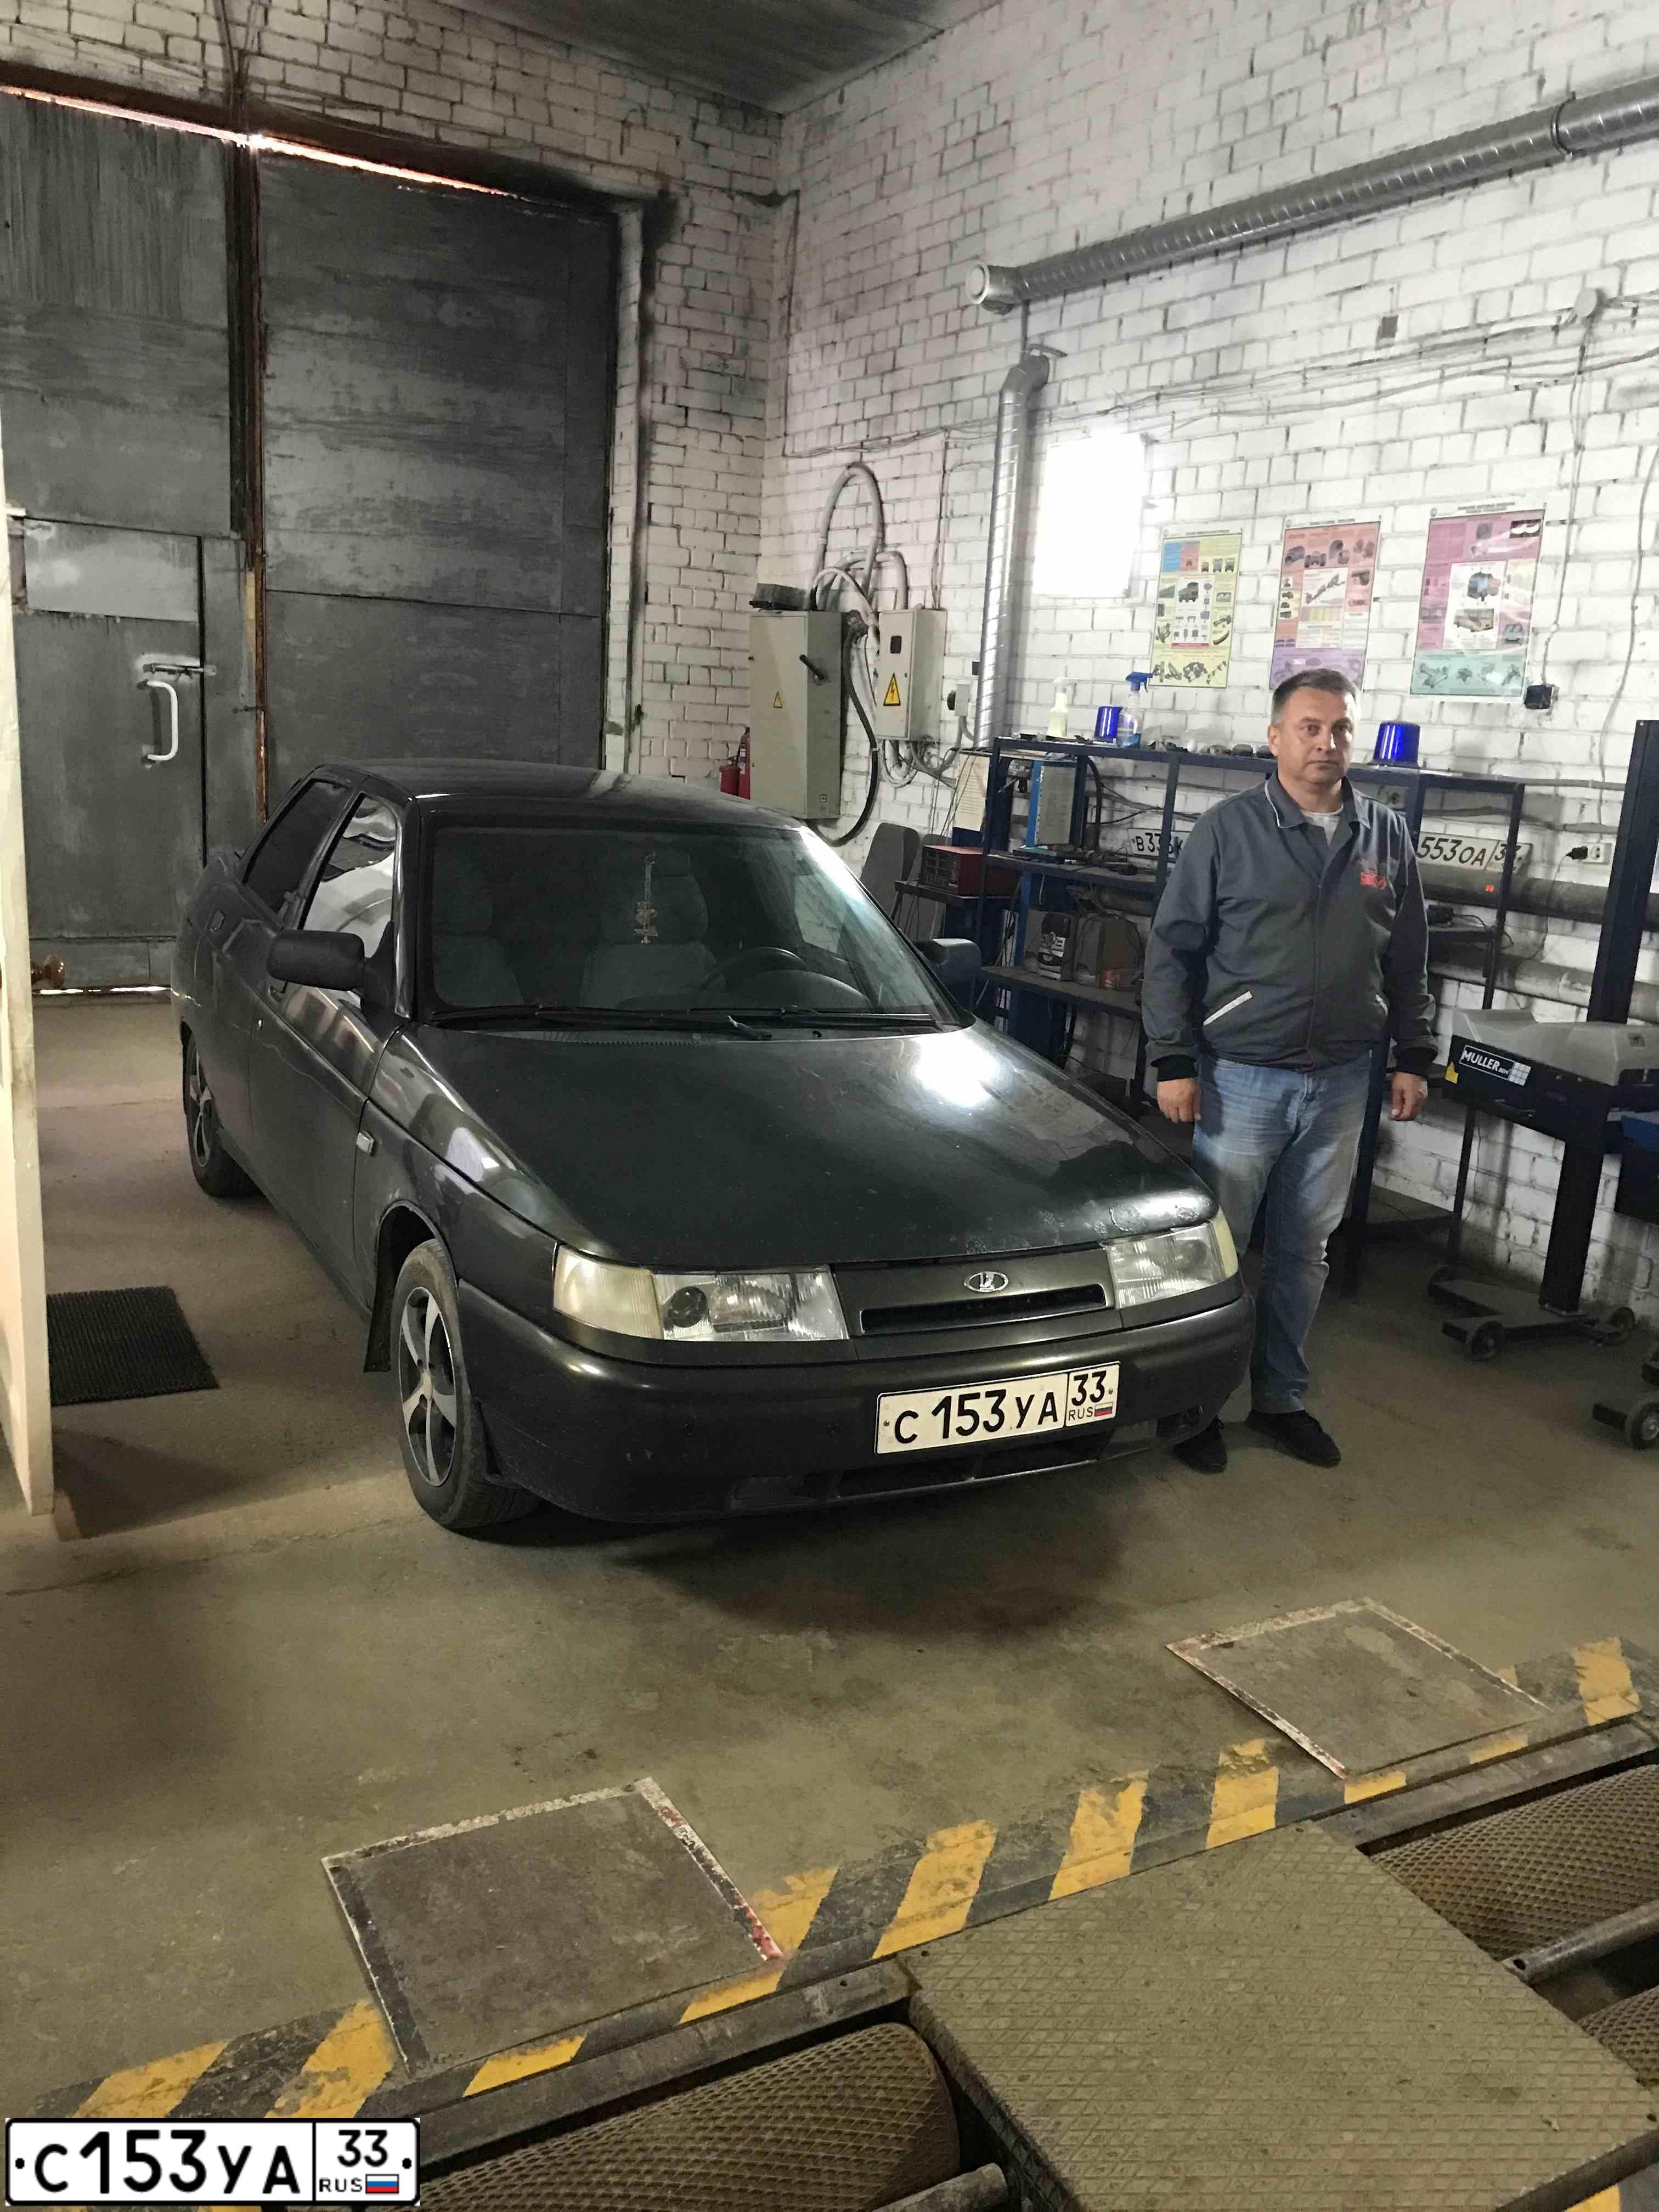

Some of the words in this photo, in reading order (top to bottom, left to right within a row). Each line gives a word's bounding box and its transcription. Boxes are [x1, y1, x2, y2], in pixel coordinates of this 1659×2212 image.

[1460, 1049, 1500, 1071] MULLER
[1071, 1371, 1107, 1406] 33
[1068, 1406, 1093, 1421] RUS
